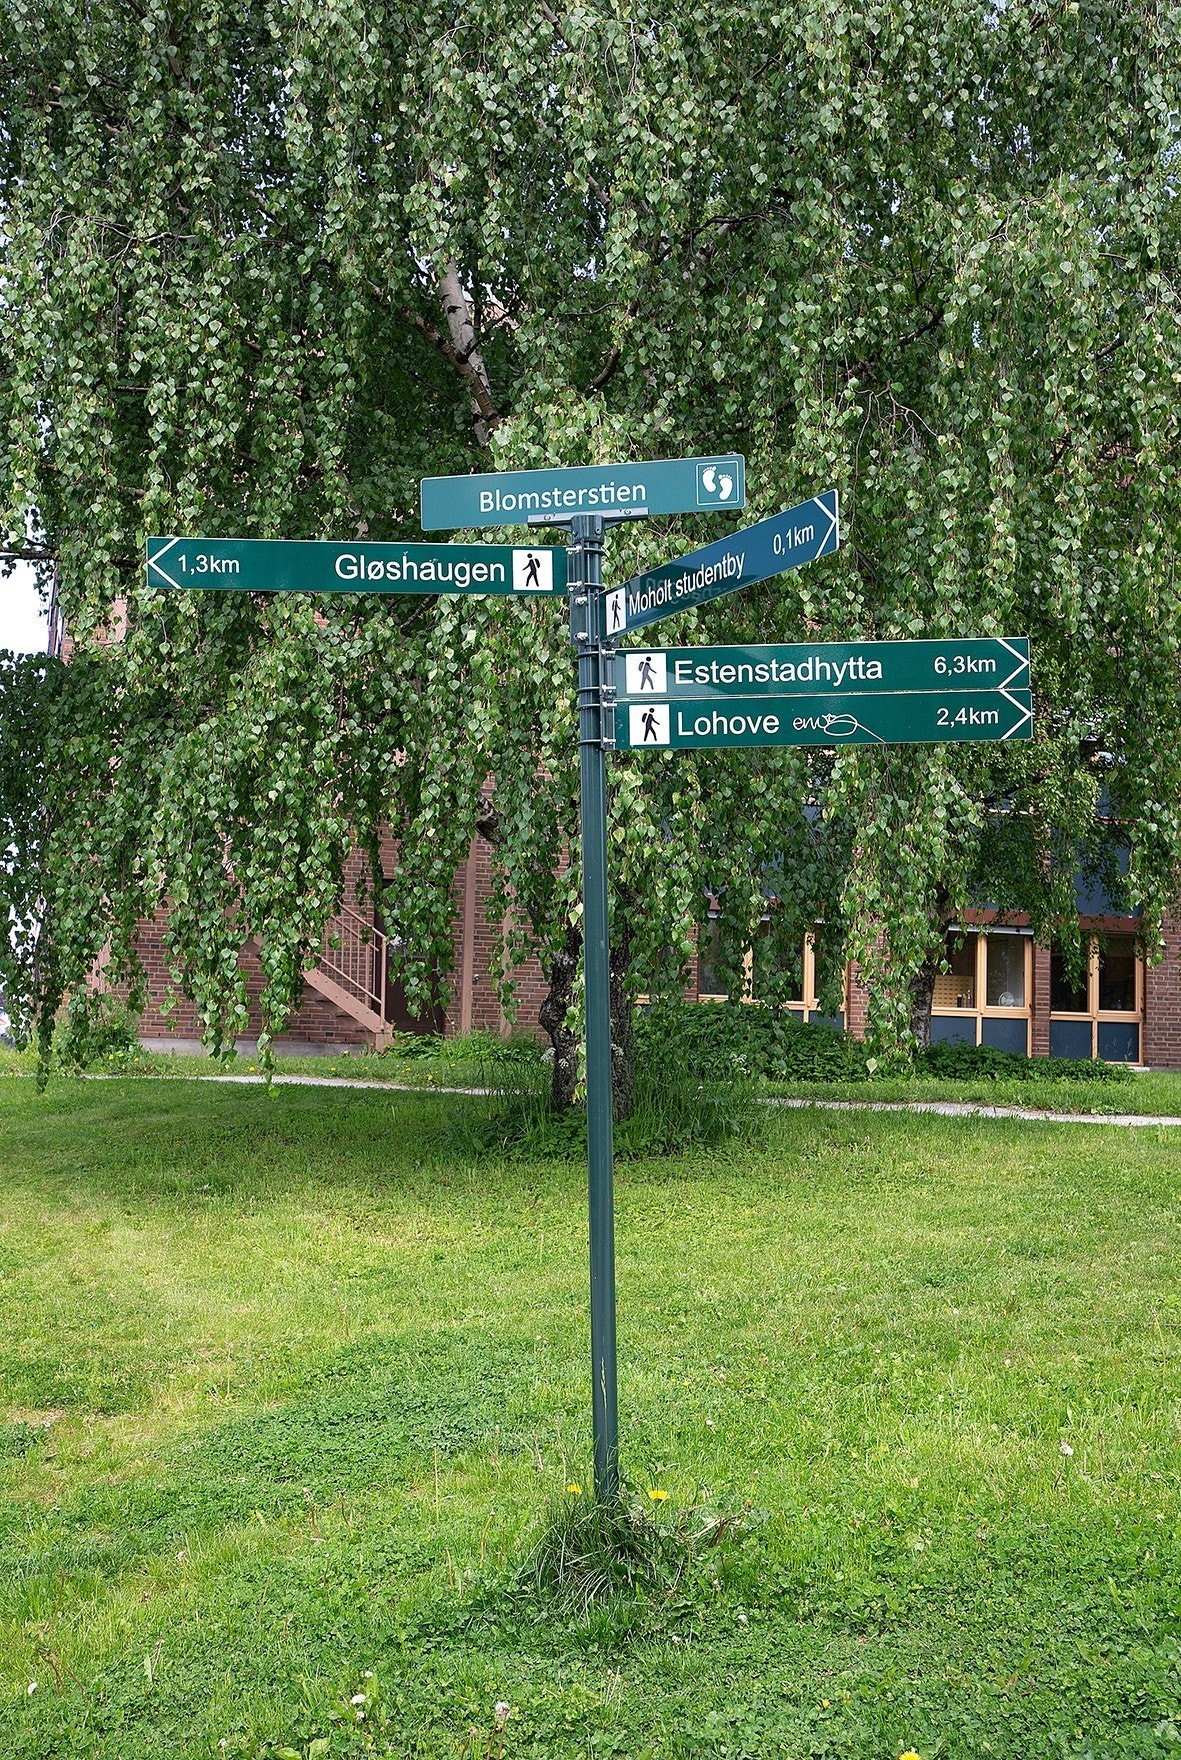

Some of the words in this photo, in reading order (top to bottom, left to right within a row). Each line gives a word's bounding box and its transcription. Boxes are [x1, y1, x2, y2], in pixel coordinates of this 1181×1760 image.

[480, 482, 647, 513] Blomsterstien
[177, 554, 240, 575] 1,3km
[335, 553, 505, 588] Gløshaugen
[628, 580, 673, 617] Moholt
[675, 552, 746, 597] studentby
[773, 524, 815, 556] 0,1km
[674, 656, 883, 687] Estenstadhytta
[934, 655, 996, 677] 6,3km
[677, 710, 780, 736] Lohove
[936, 706, 1000, 728] 2,4km
